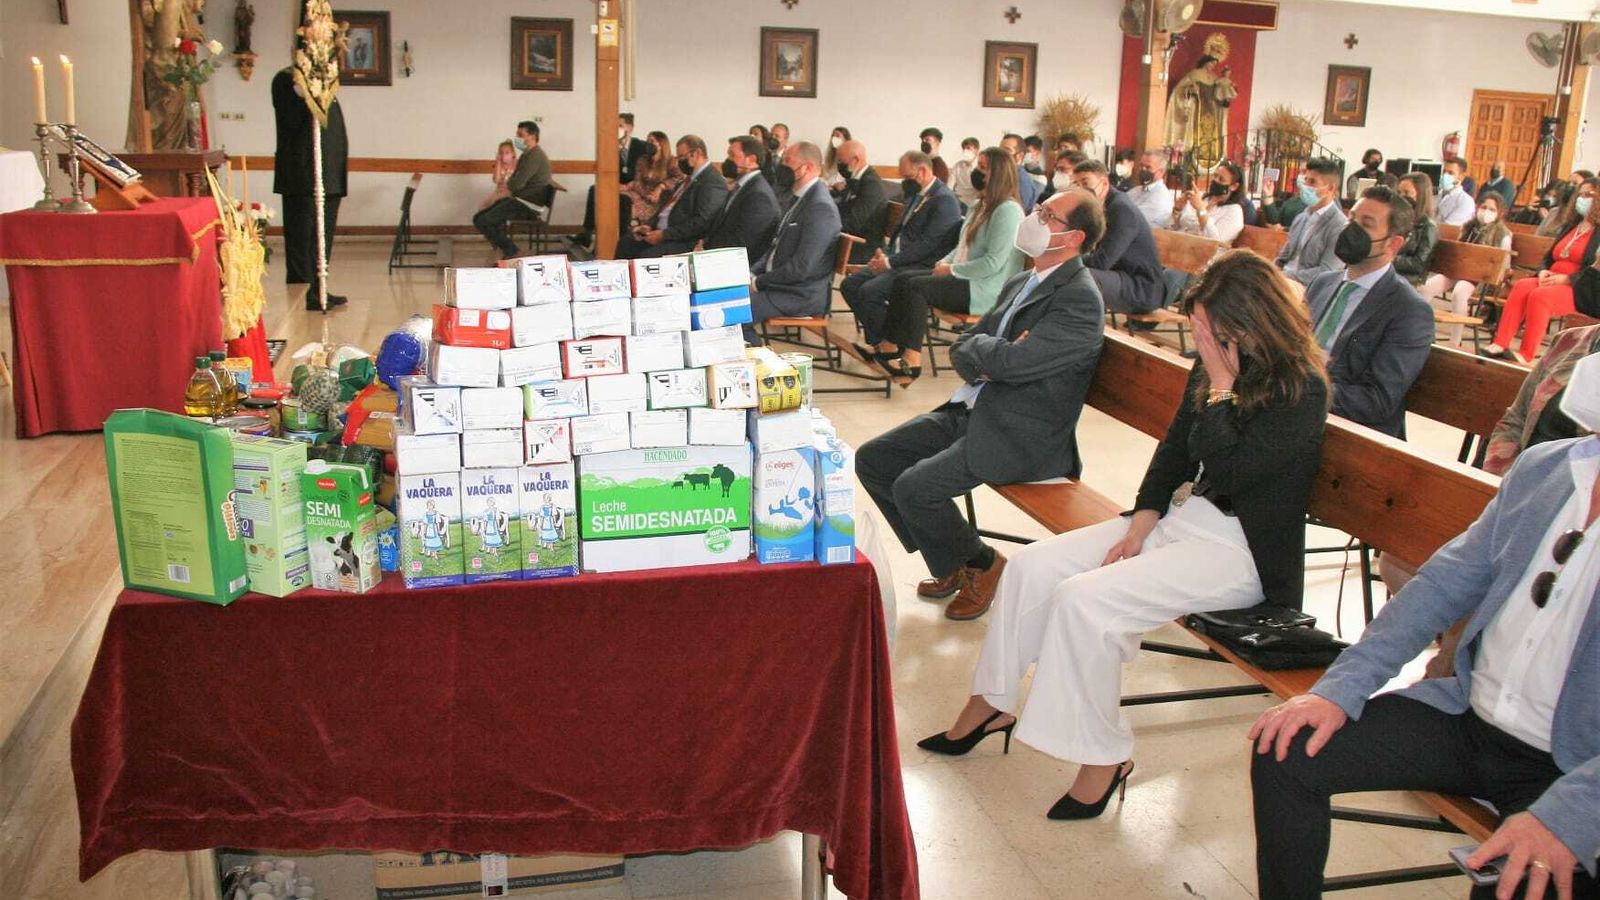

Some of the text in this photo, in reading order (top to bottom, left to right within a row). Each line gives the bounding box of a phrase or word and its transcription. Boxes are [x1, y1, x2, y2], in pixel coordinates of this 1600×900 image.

[644, 450, 688, 461] HACENDADO
[483, 475, 495, 485] LA
[540, 471, 552, 481] LA
[423, 478, 435, 488] LA
[523, 480, 569, 492] VAQUERA
[406, 487, 453, 499] VAQUERA
[466, 484, 513, 496] VAQUERA
[306, 500, 342, 518] SEMI
[592, 499, 627, 513] Leche
[306, 516, 352, 529] DESNATADA
[592, 507, 738, 533] SEMIDESNATADA
